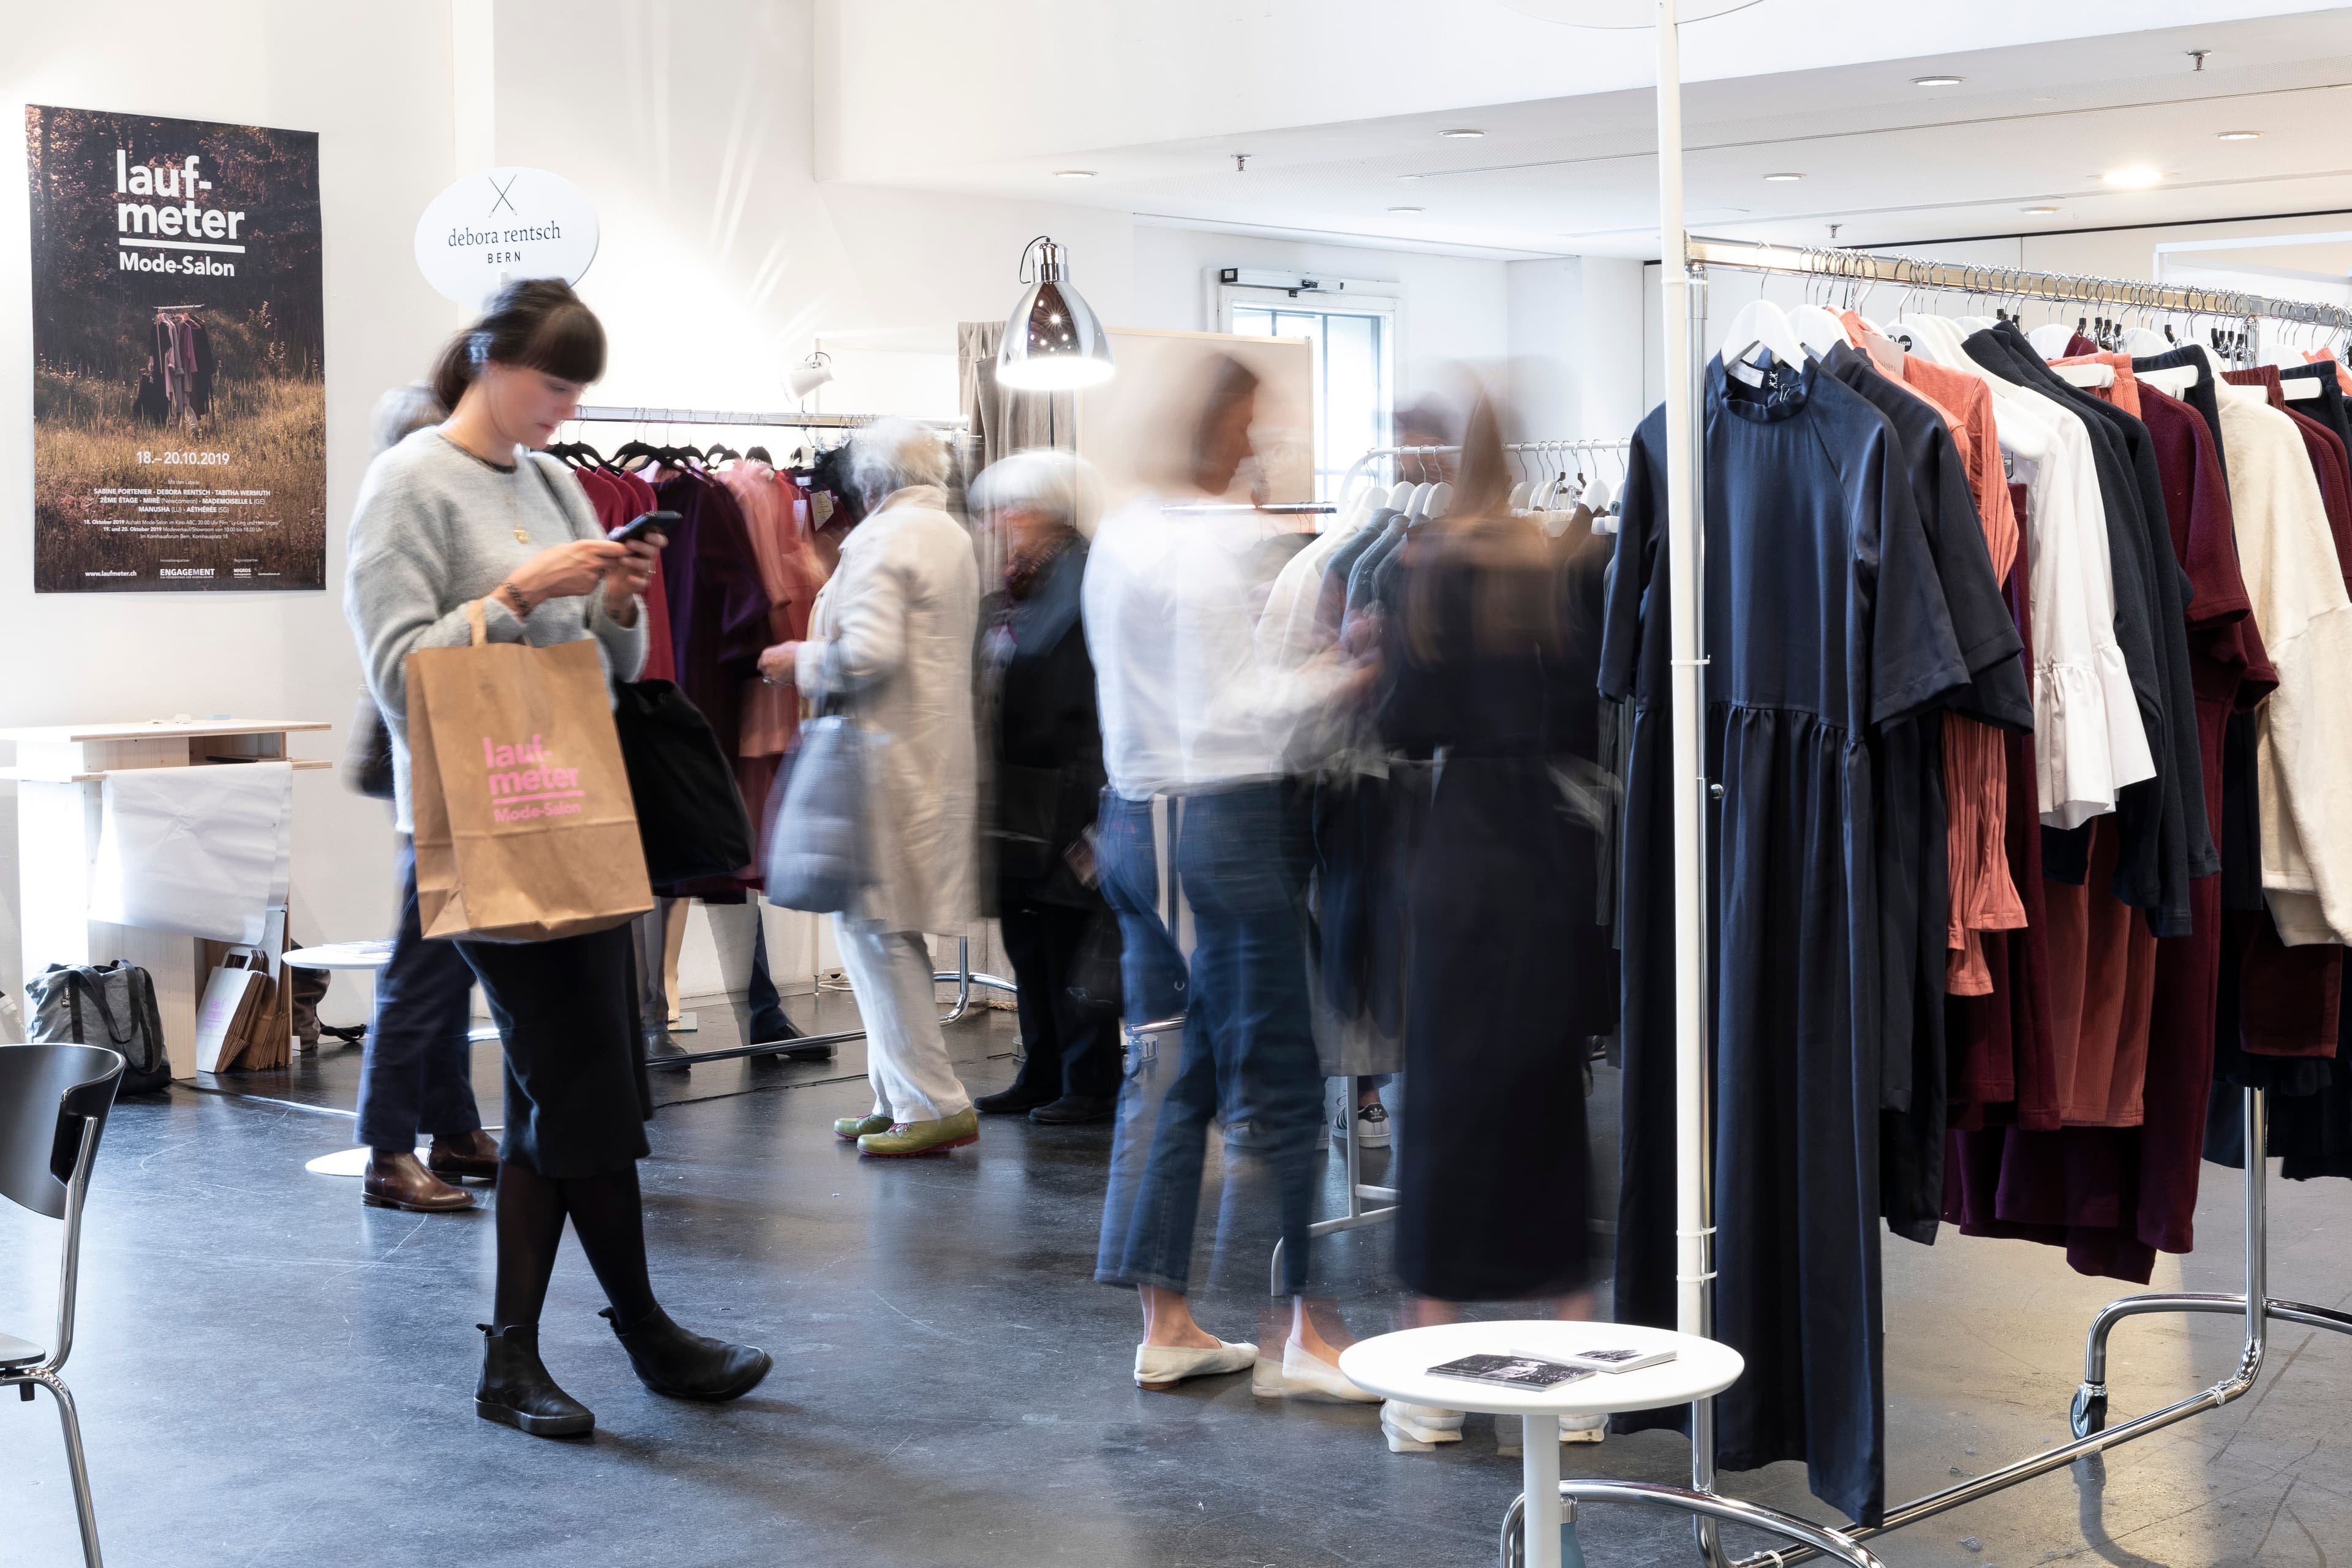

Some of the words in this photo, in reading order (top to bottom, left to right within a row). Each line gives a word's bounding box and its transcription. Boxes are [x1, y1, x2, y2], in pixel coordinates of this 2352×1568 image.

[116, 149, 212, 198] lauf-
[118, 200, 245, 239] meter
[448, 227, 499, 247] debora
[504, 221, 561, 243] rentsch
[119, 251, 235, 277] Mode-Salon
[488, 251, 521, 263] BERN
[483, 733, 552, 769] lauf-
[489, 763, 579, 796] meter
[493, 802, 582, 823] Mode-Salon
